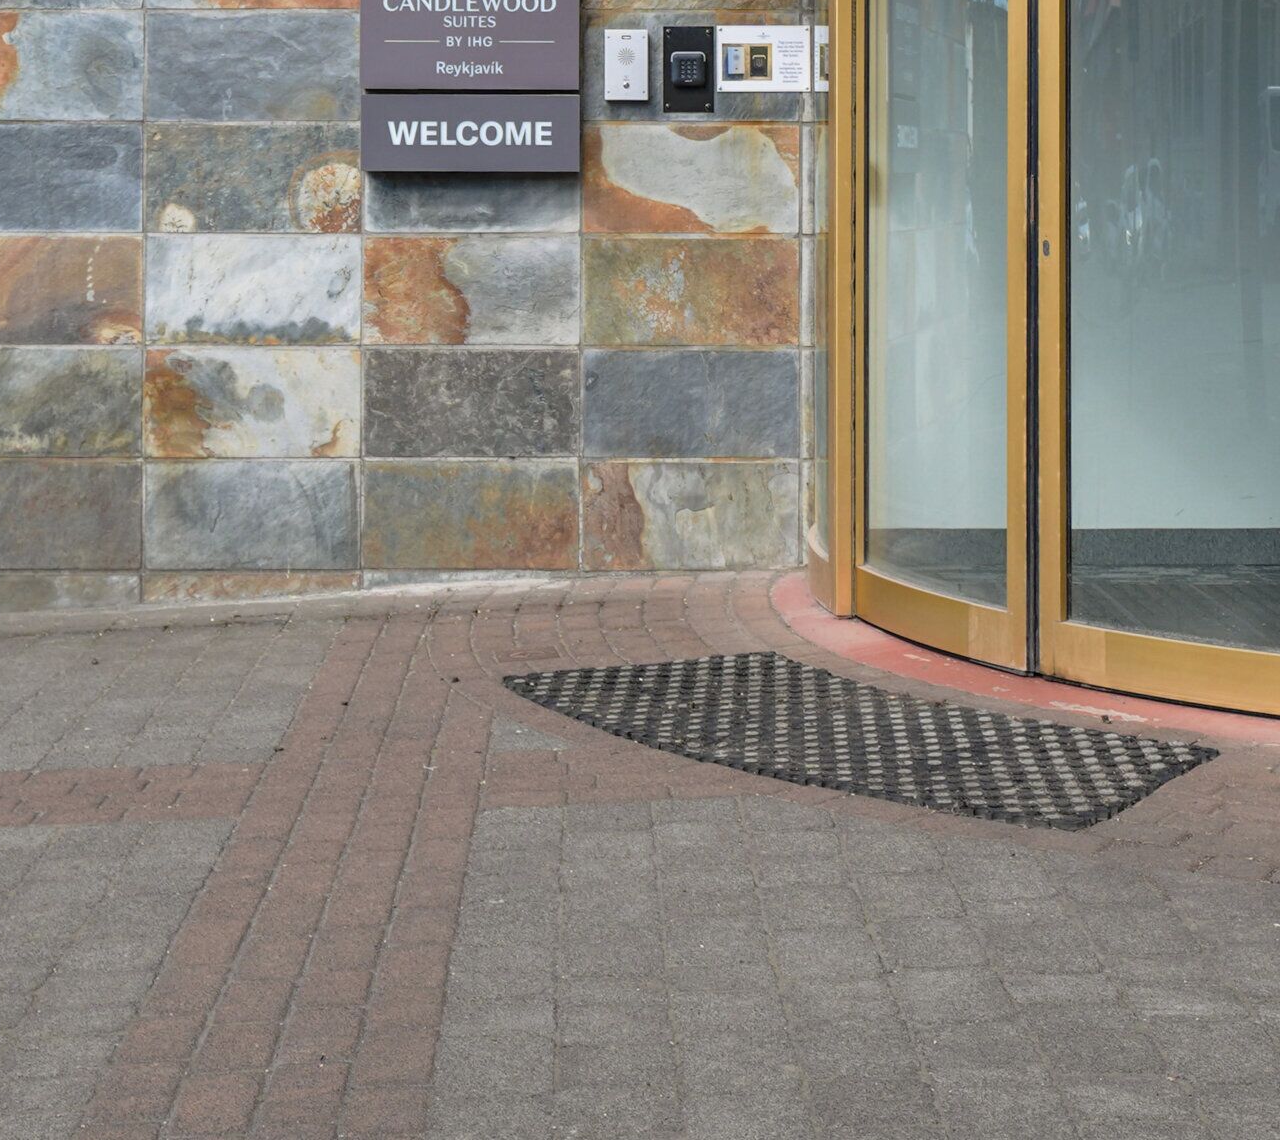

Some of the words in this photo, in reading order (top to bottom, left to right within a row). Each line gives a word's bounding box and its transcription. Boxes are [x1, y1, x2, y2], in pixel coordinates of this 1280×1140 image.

[443, 15, 497, 28] SUITES
[446, 35, 463, 48] BY
[467, 35, 493, 48] IHG
[435, 60, 504, 78] Reykjavík
[387, 120, 553, 147] WELCOME
